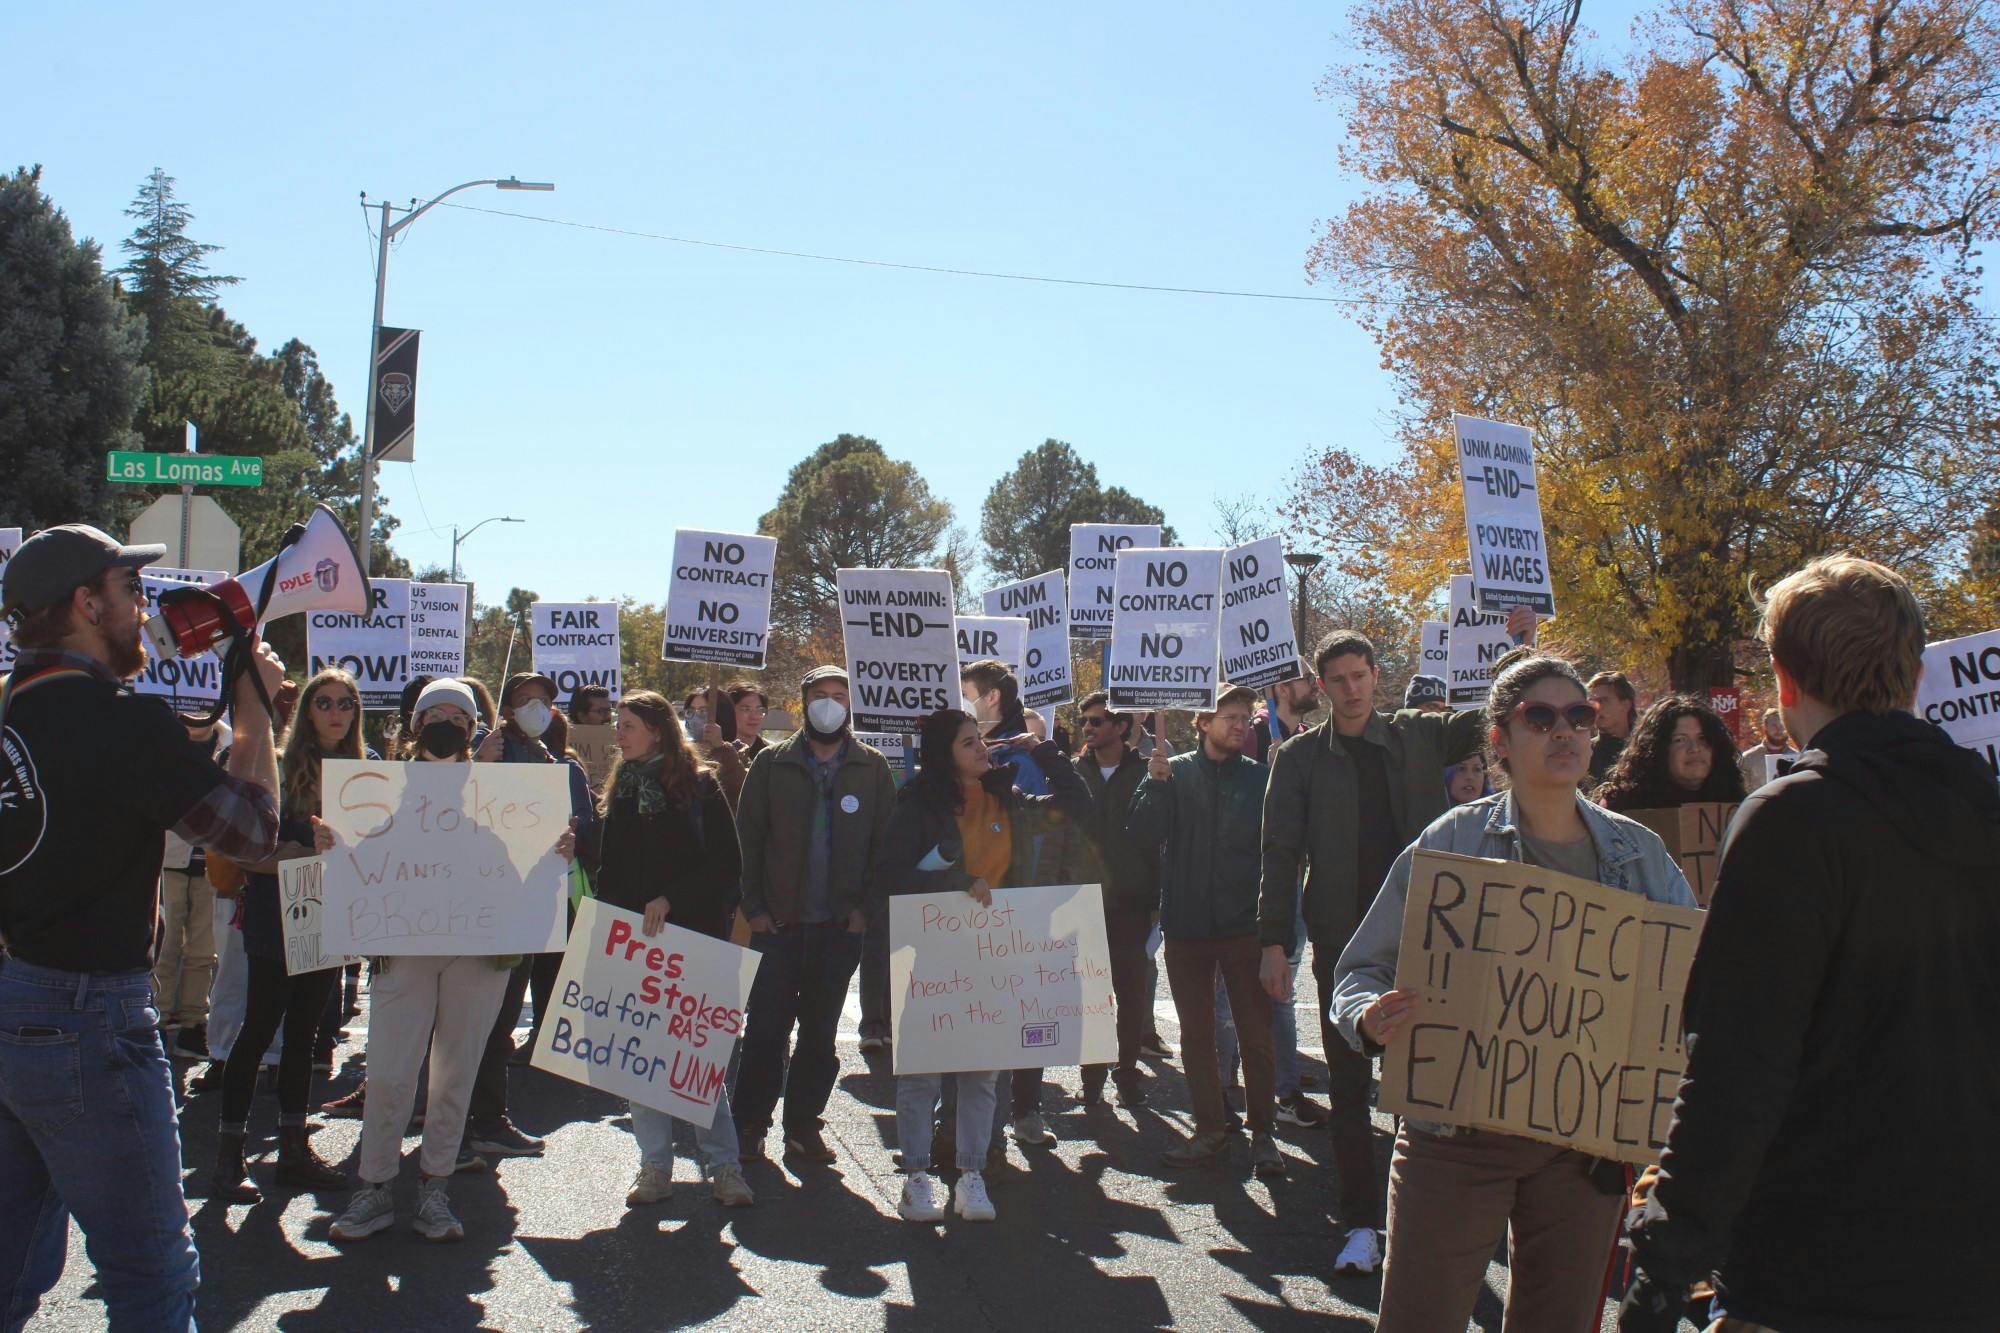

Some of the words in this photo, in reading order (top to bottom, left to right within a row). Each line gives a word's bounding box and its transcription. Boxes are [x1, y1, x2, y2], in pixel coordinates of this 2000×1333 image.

[1462, 438, 1491, 459] UNM
[1494, 442, 1532, 466] ADMIN:
[110, 454, 146, 478] Las
[156, 456, 223, 481] Lomas
[231, 459, 260, 476] Ave
[1098, 535, 1134, 553] NO
[1477, 524, 1538, 551] POVERTY
[704, 541, 745, 565] NO
[1074, 558, 1117, 570] CONT
[676, 566, 768, 588] CONTRACT
[1146, 561, 1188, 588] NO
[1229, 554, 1259, 584] NO
[1481, 553, 1543, 584] WAGES
[279, 571, 312, 593] PYLE
[412, 588, 426, 597] US
[421, 601, 459, 612] VISION
[844, 589, 881, 605] UNM
[885, 590, 946, 607] ADMIN:
[1000, 581, 1046, 611] UNM
[1096, 586, 1114, 605] N
[1119, 594, 1214, 611] CONTRACT
[312, 614, 406, 629] CONTRACT
[411, 613, 425, 623] US
[551, 611, 600, 629] FAIR
[698, 600, 739, 625] NO
[1016, 605, 1061, 631] MIN:
[1070, 609, 1114, 622] UNIVE
[1453, 607, 1508, 628] ADM
[418, 628, 459, 639] DENTAL
[536, 633, 615, 647] CONTRACT
[667, 624, 765, 647] UNIVERSITY
[957, 629, 999, 656] AIR
[1239, 618, 1270, 647] NO
[411, 650, 460, 661] WORKERS
[1026, 648, 1042, 668] O
[1140, 633, 1183, 659] NO
[1225, 640, 1294, 674] UNIVERSITY
[138, 658, 218, 690] NOW!
[411, 662, 458, 673] SENTIAL!
[856, 661, 948, 683] POVERTY
[1024, 666, 1066, 688] BACKS!
[1110, 665, 1212, 683] UNIVERSITY
[1950, 647, 2000, 688] NO
[858, 684, 949, 710] WAGES
[1925, 691, 2000, 725] CONTR
[862, 716, 879, 725] United
[880, 718, 903, 726] Graduate
[16, 765, 35, 799] UNITED
[339, 771, 542, 838] Stokes
[922, 901, 1015, 934] Provost
[976, 929, 1079, 960] Holloway
[1423, 871, 1692, 992] RESPECT
[910, 969, 974, 999] heats
[991, 973, 1024, 996] up
[562, 980, 613, 1018] Bad
[616, 993, 661, 1031] for
[640, 975, 742, 1035] Stokes
[932, 1007, 954, 1032] in
[967, 1000, 1004, 1024] the
[1497, 965, 1605, 1052] YOUR
[552, 1016, 615, 1067] Bad
[618, 1036, 667, 1083] for
[669, 1050, 726, 1103] UNM
[1406, 1023, 1683, 1148] EMPLOYEE
